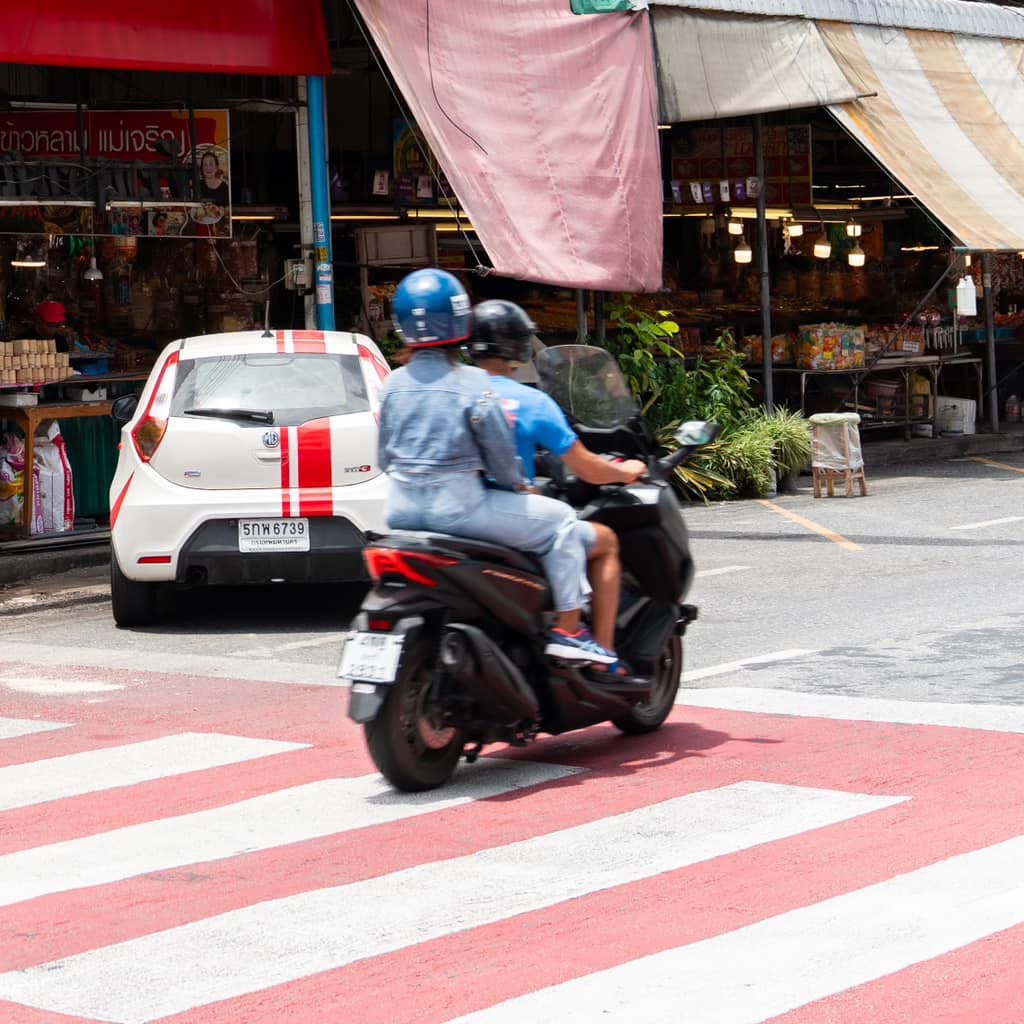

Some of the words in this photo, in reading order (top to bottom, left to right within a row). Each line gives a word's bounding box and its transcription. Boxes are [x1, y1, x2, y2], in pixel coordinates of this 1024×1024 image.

[0, 120, 88, 152] ข้าวหลาม
[273, 522, 305, 535] 6739
